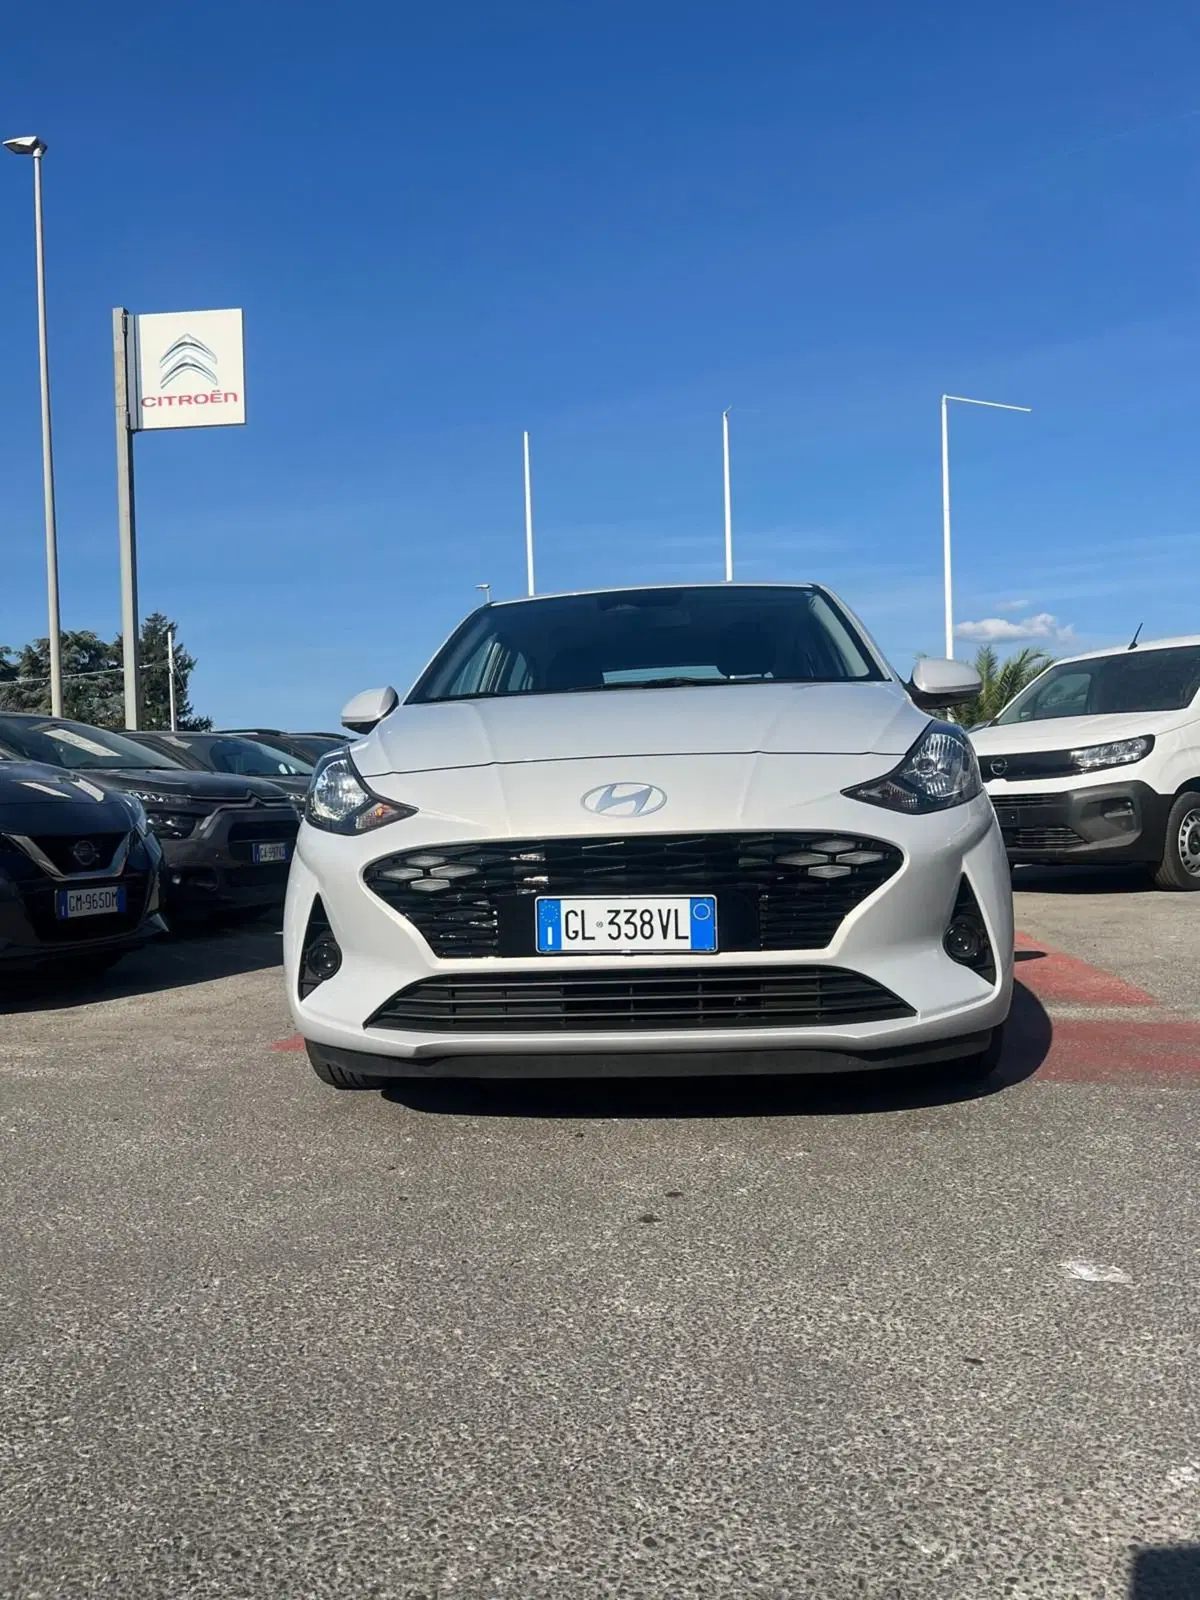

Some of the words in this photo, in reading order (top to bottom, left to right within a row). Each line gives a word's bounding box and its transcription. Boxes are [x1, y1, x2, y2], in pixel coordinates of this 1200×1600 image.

[547, 926, 553, 946] I
[564, 909, 596, 941] GL
[606, 908, 689, 941] 338VL
